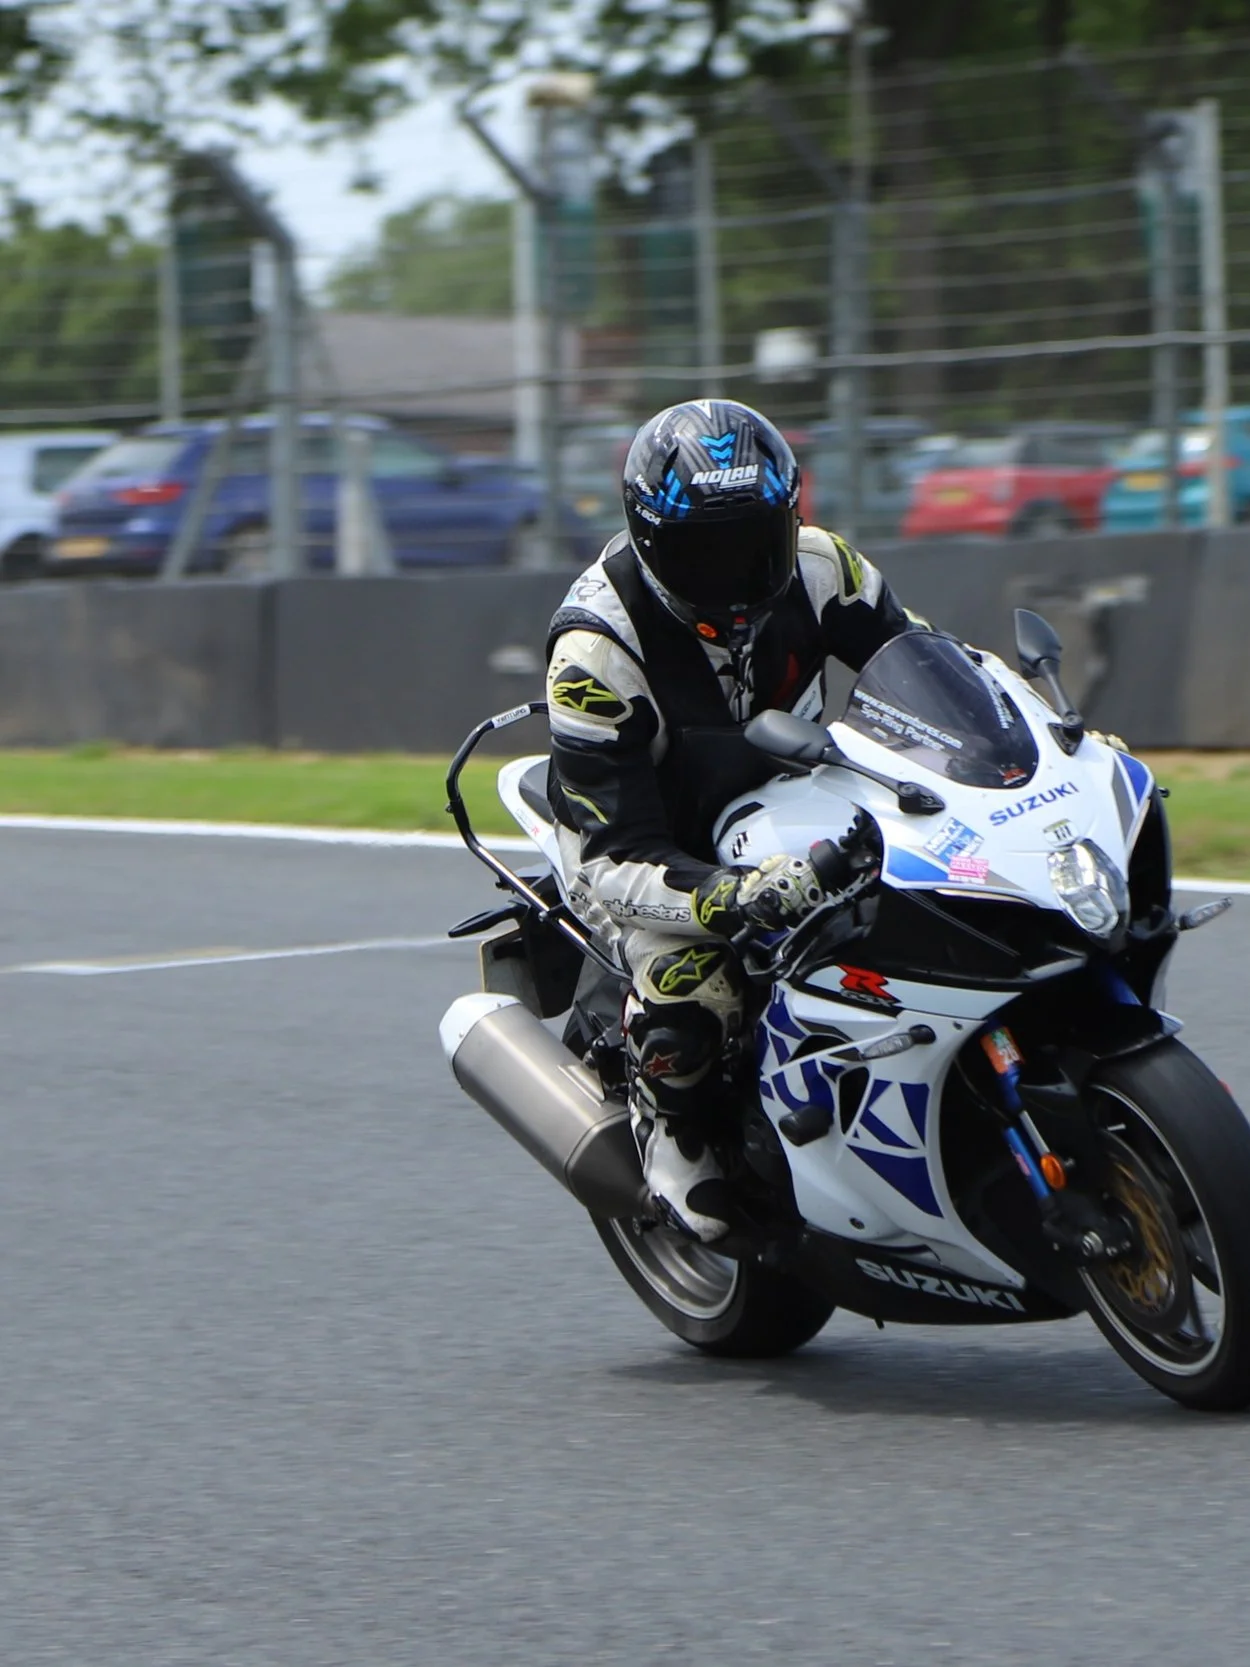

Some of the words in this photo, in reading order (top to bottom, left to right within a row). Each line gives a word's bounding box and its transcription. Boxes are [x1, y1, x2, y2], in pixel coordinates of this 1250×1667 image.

[691, 464, 759, 490] NOLAN
[989, 781, 1080, 826] SUZUKI
[602, 898, 692, 922] alpinestars
[855, 1258, 1027, 1313] SUZUKI
